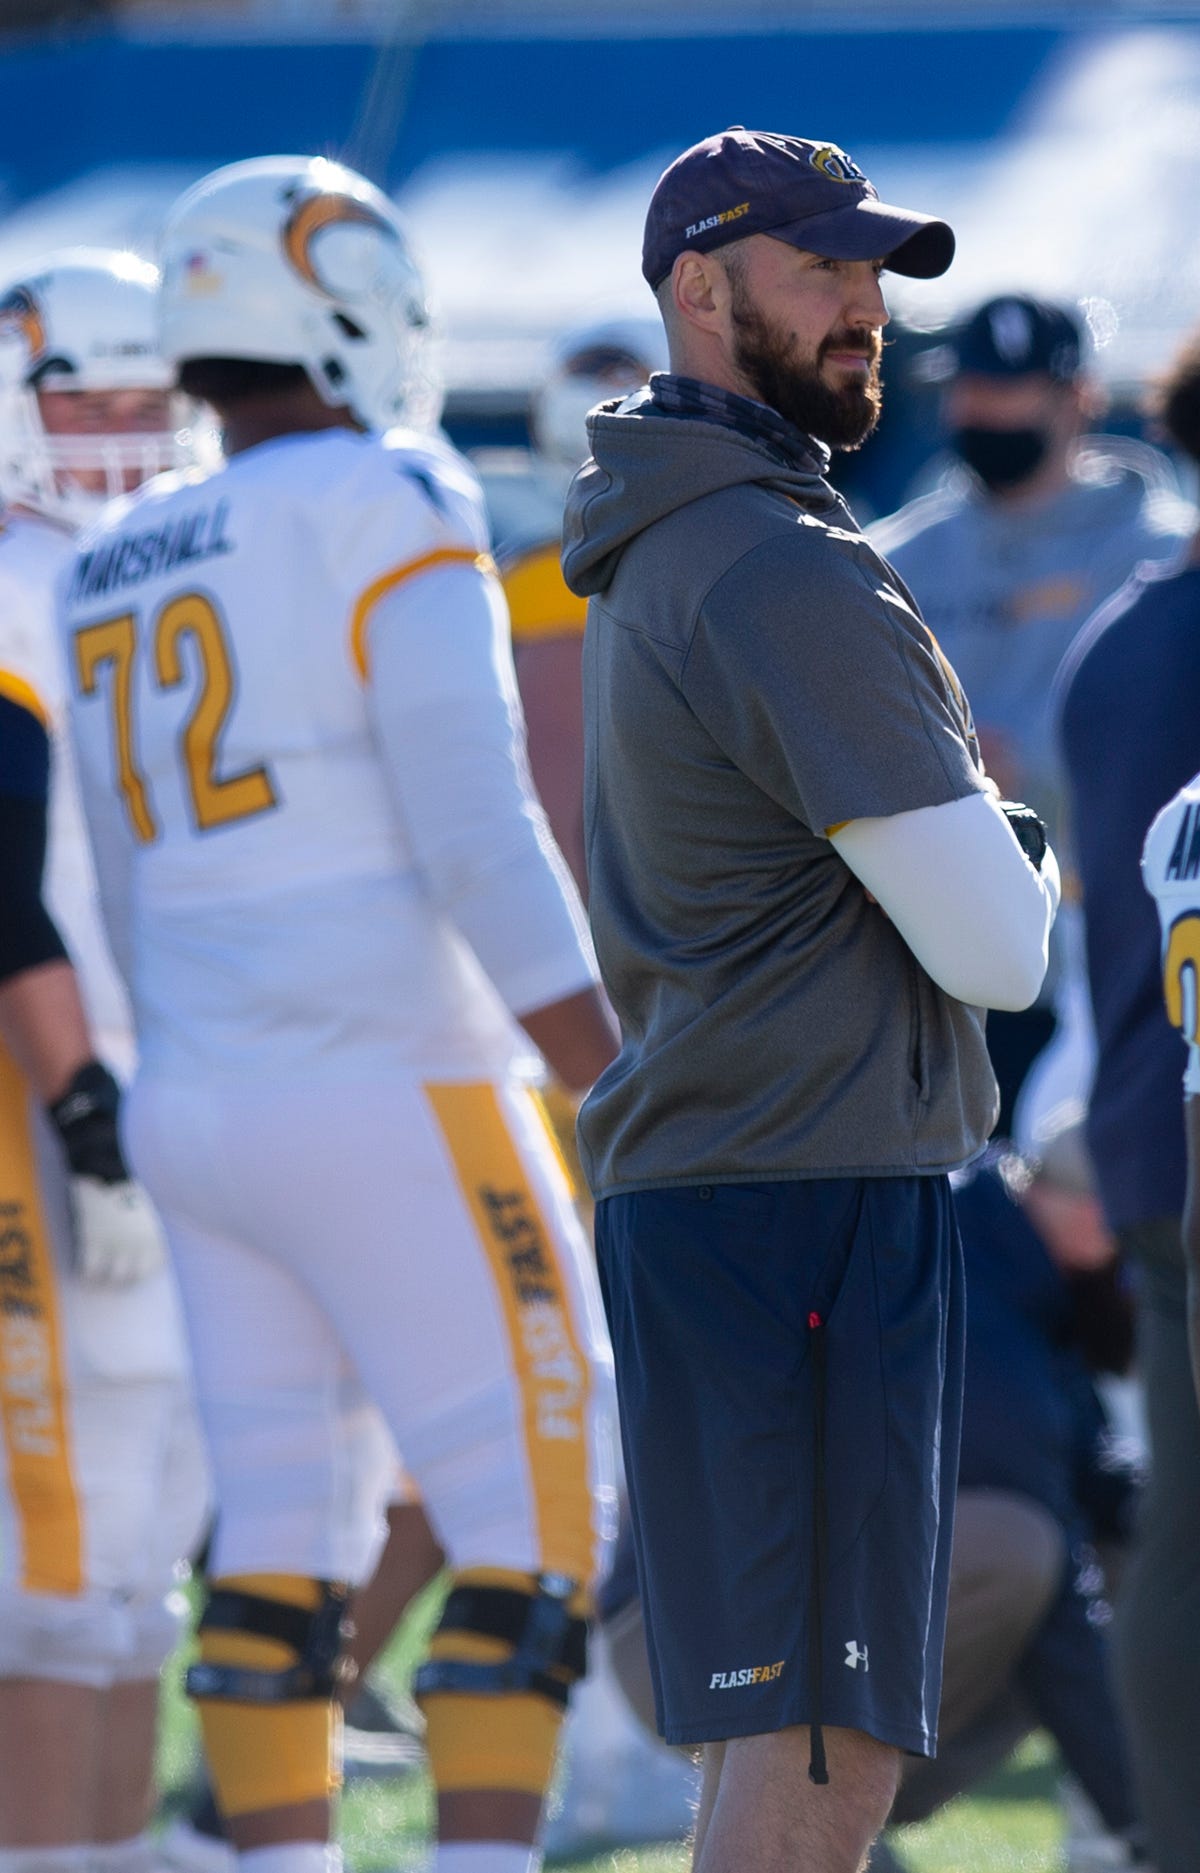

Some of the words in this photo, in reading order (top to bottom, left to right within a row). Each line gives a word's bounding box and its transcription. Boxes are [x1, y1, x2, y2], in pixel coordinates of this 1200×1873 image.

[684, 201, 751, 239] FLASHFAST
[72, 588, 283, 848] 72
[709, 1660, 785, 1690] FLASHFAST
